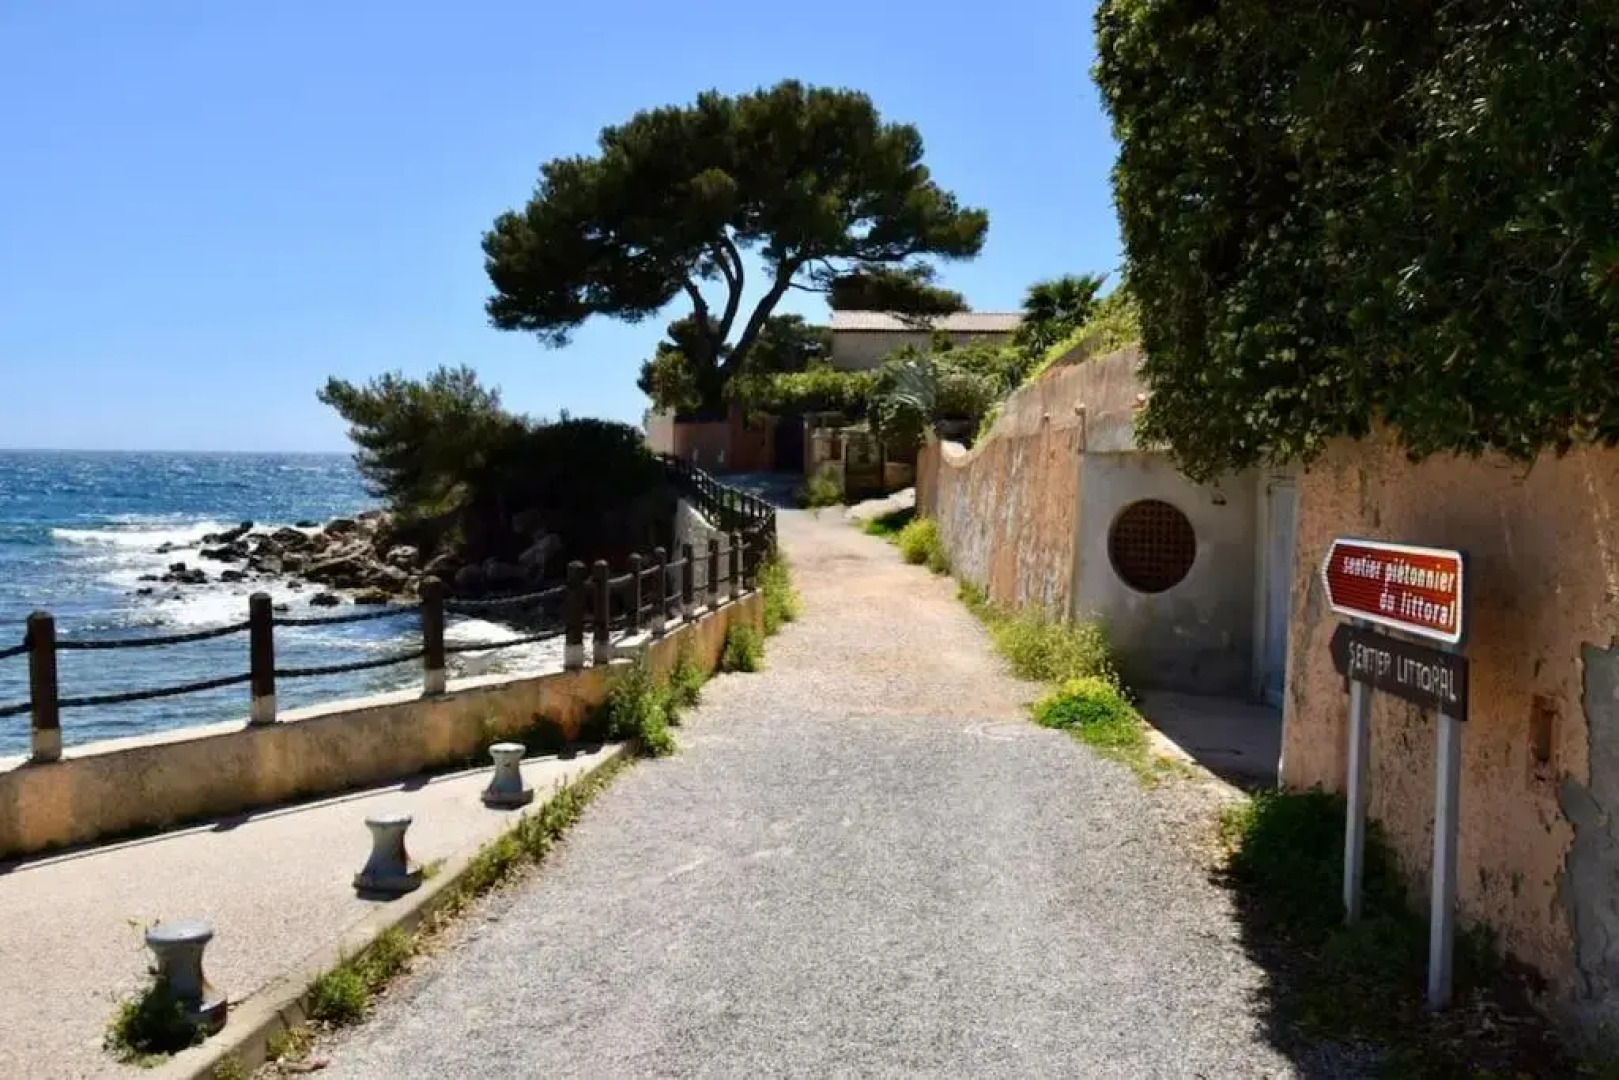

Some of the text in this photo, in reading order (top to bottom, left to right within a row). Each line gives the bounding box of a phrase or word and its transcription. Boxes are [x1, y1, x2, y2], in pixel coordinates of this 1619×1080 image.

[1343, 554, 1454, 593] sentier piétonnier
[1400, 590, 1456, 627] littoral
[1349, 641, 1457, 702] SENTIER LITTORAL
